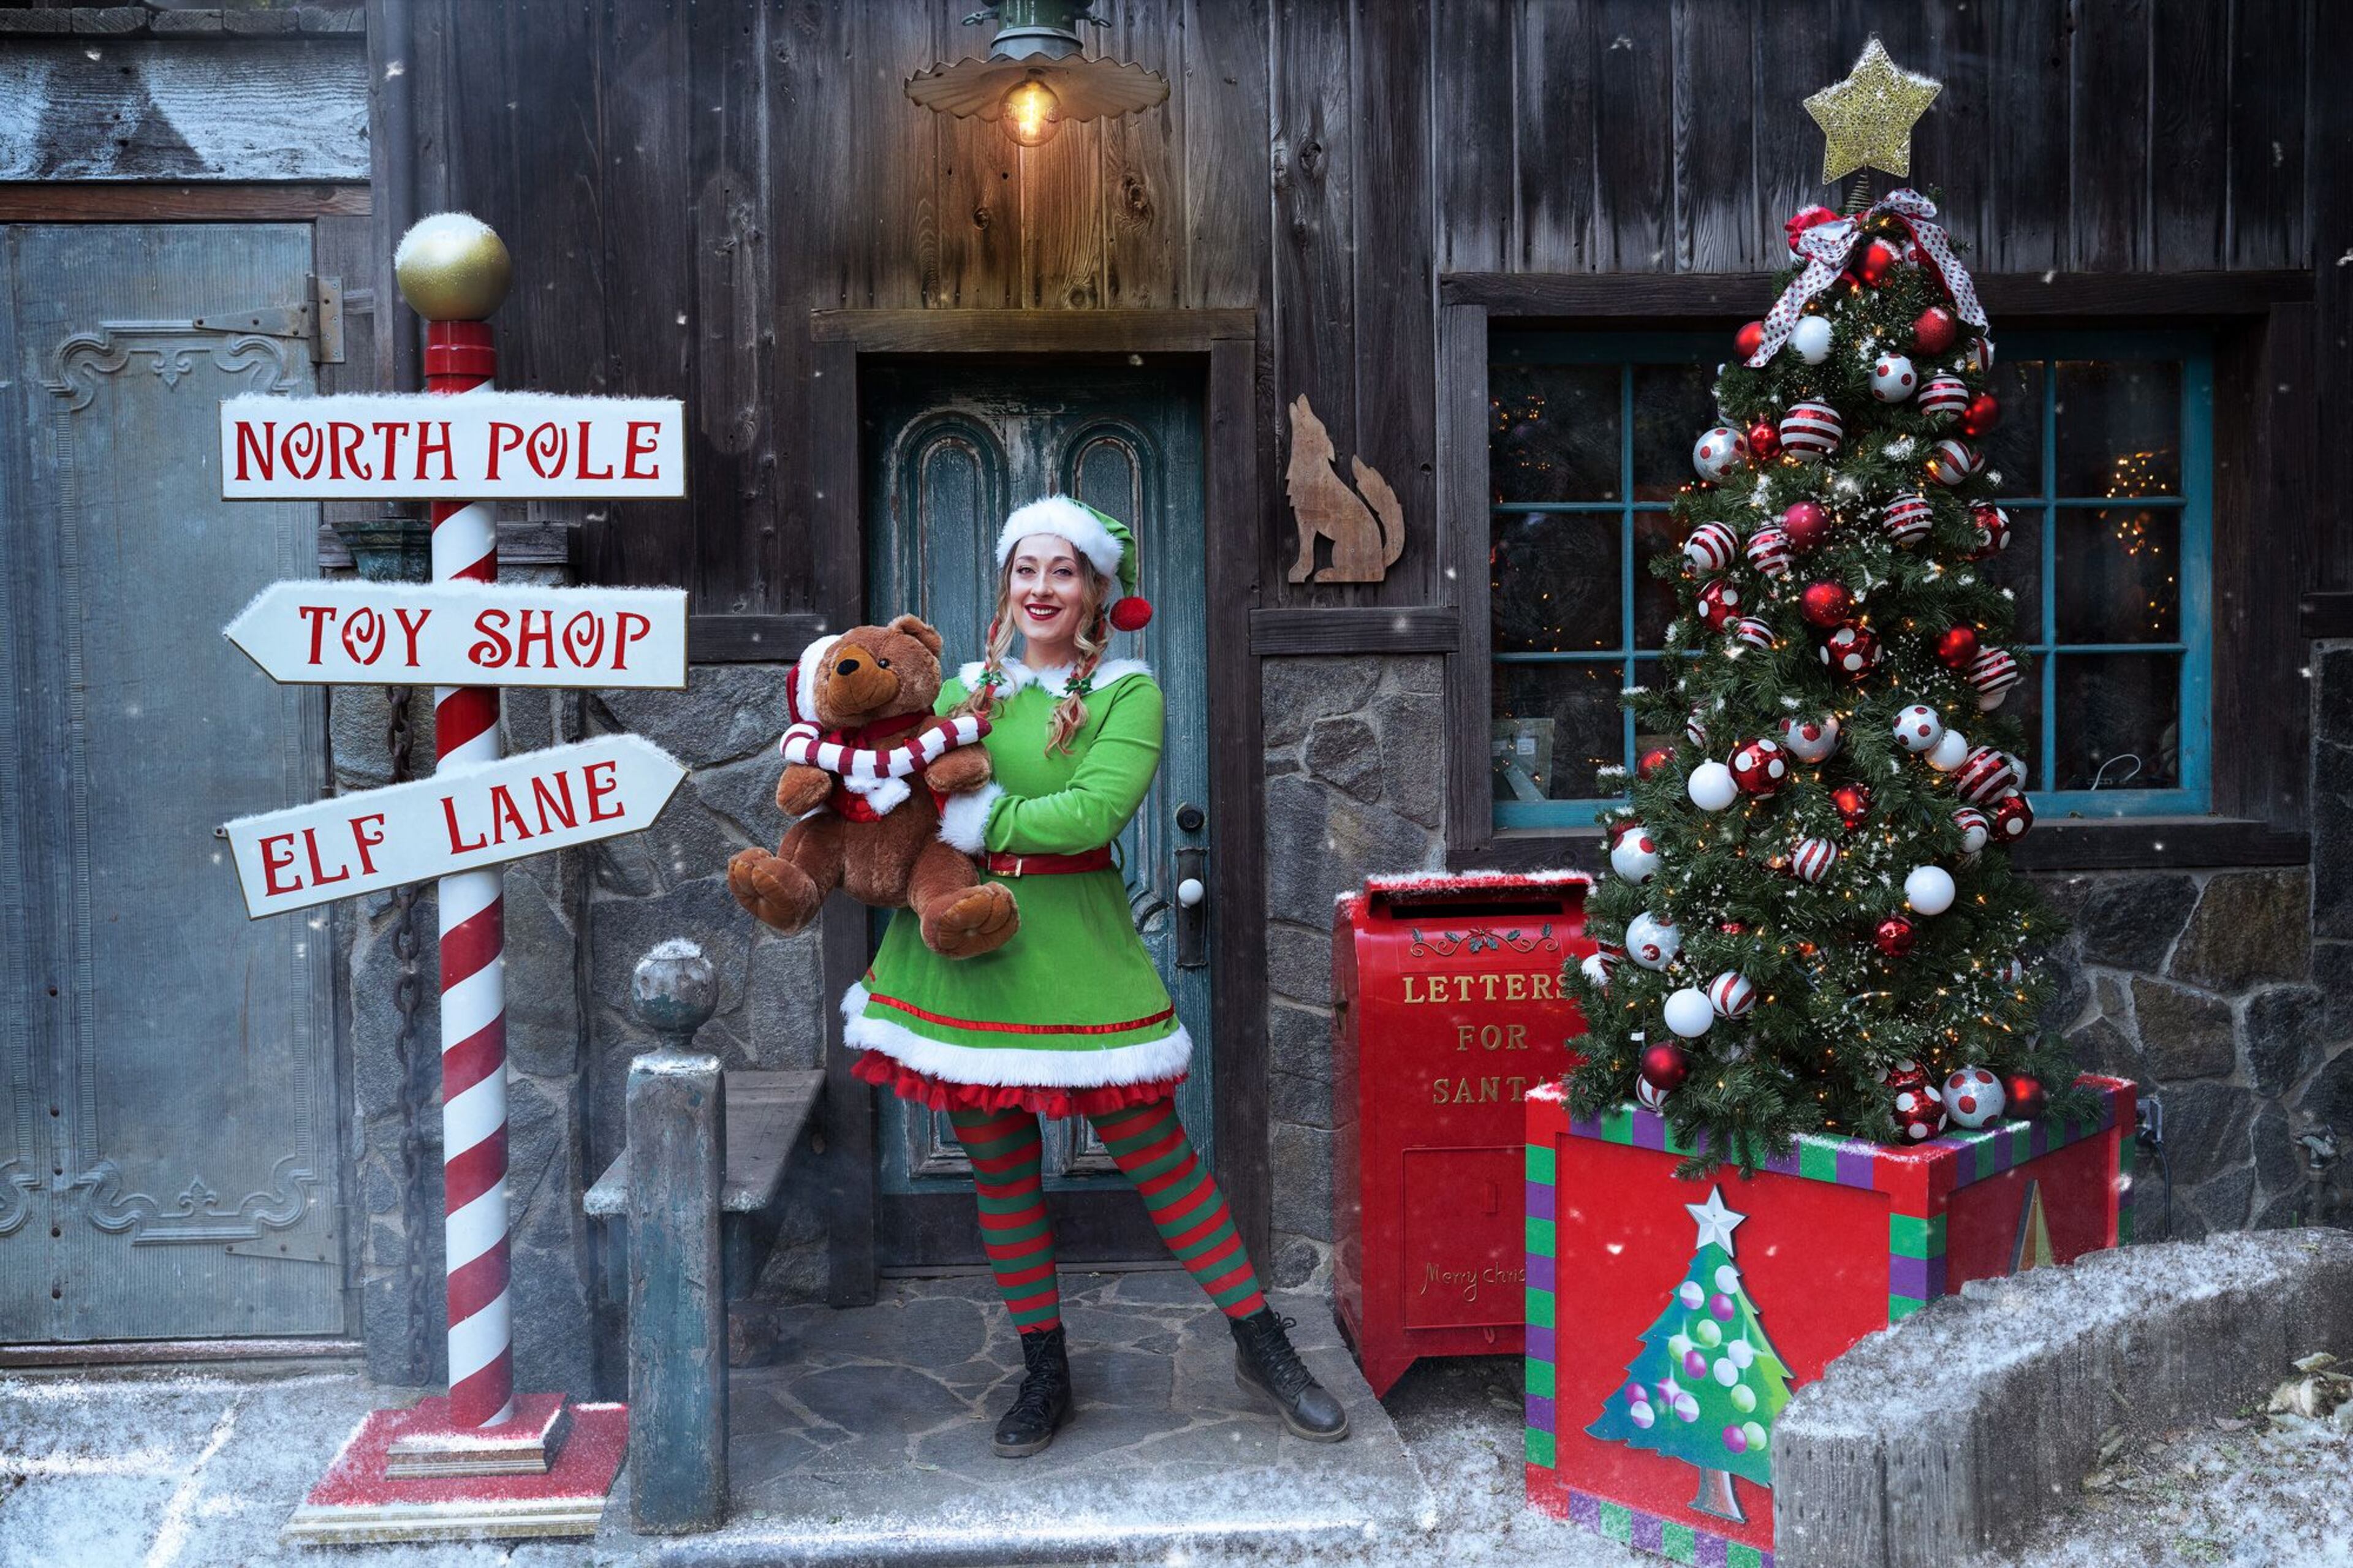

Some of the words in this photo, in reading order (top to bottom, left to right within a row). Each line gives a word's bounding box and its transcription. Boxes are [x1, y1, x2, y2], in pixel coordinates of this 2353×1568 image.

[235, 422, 458, 481] NORTH
[486, 422, 661, 480] POLE
[299, 606, 433, 667] TOY
[468, 609, 651, 670] SHOP
[259, 813, 385, 897] ELF
[441, 760, 625, 855] LANE
[1456, 1025, 1528, 1051] FOR
[1433, 1075, 1546, 1105] SANT
[1420, 1262, 1477, 1302] Merry
